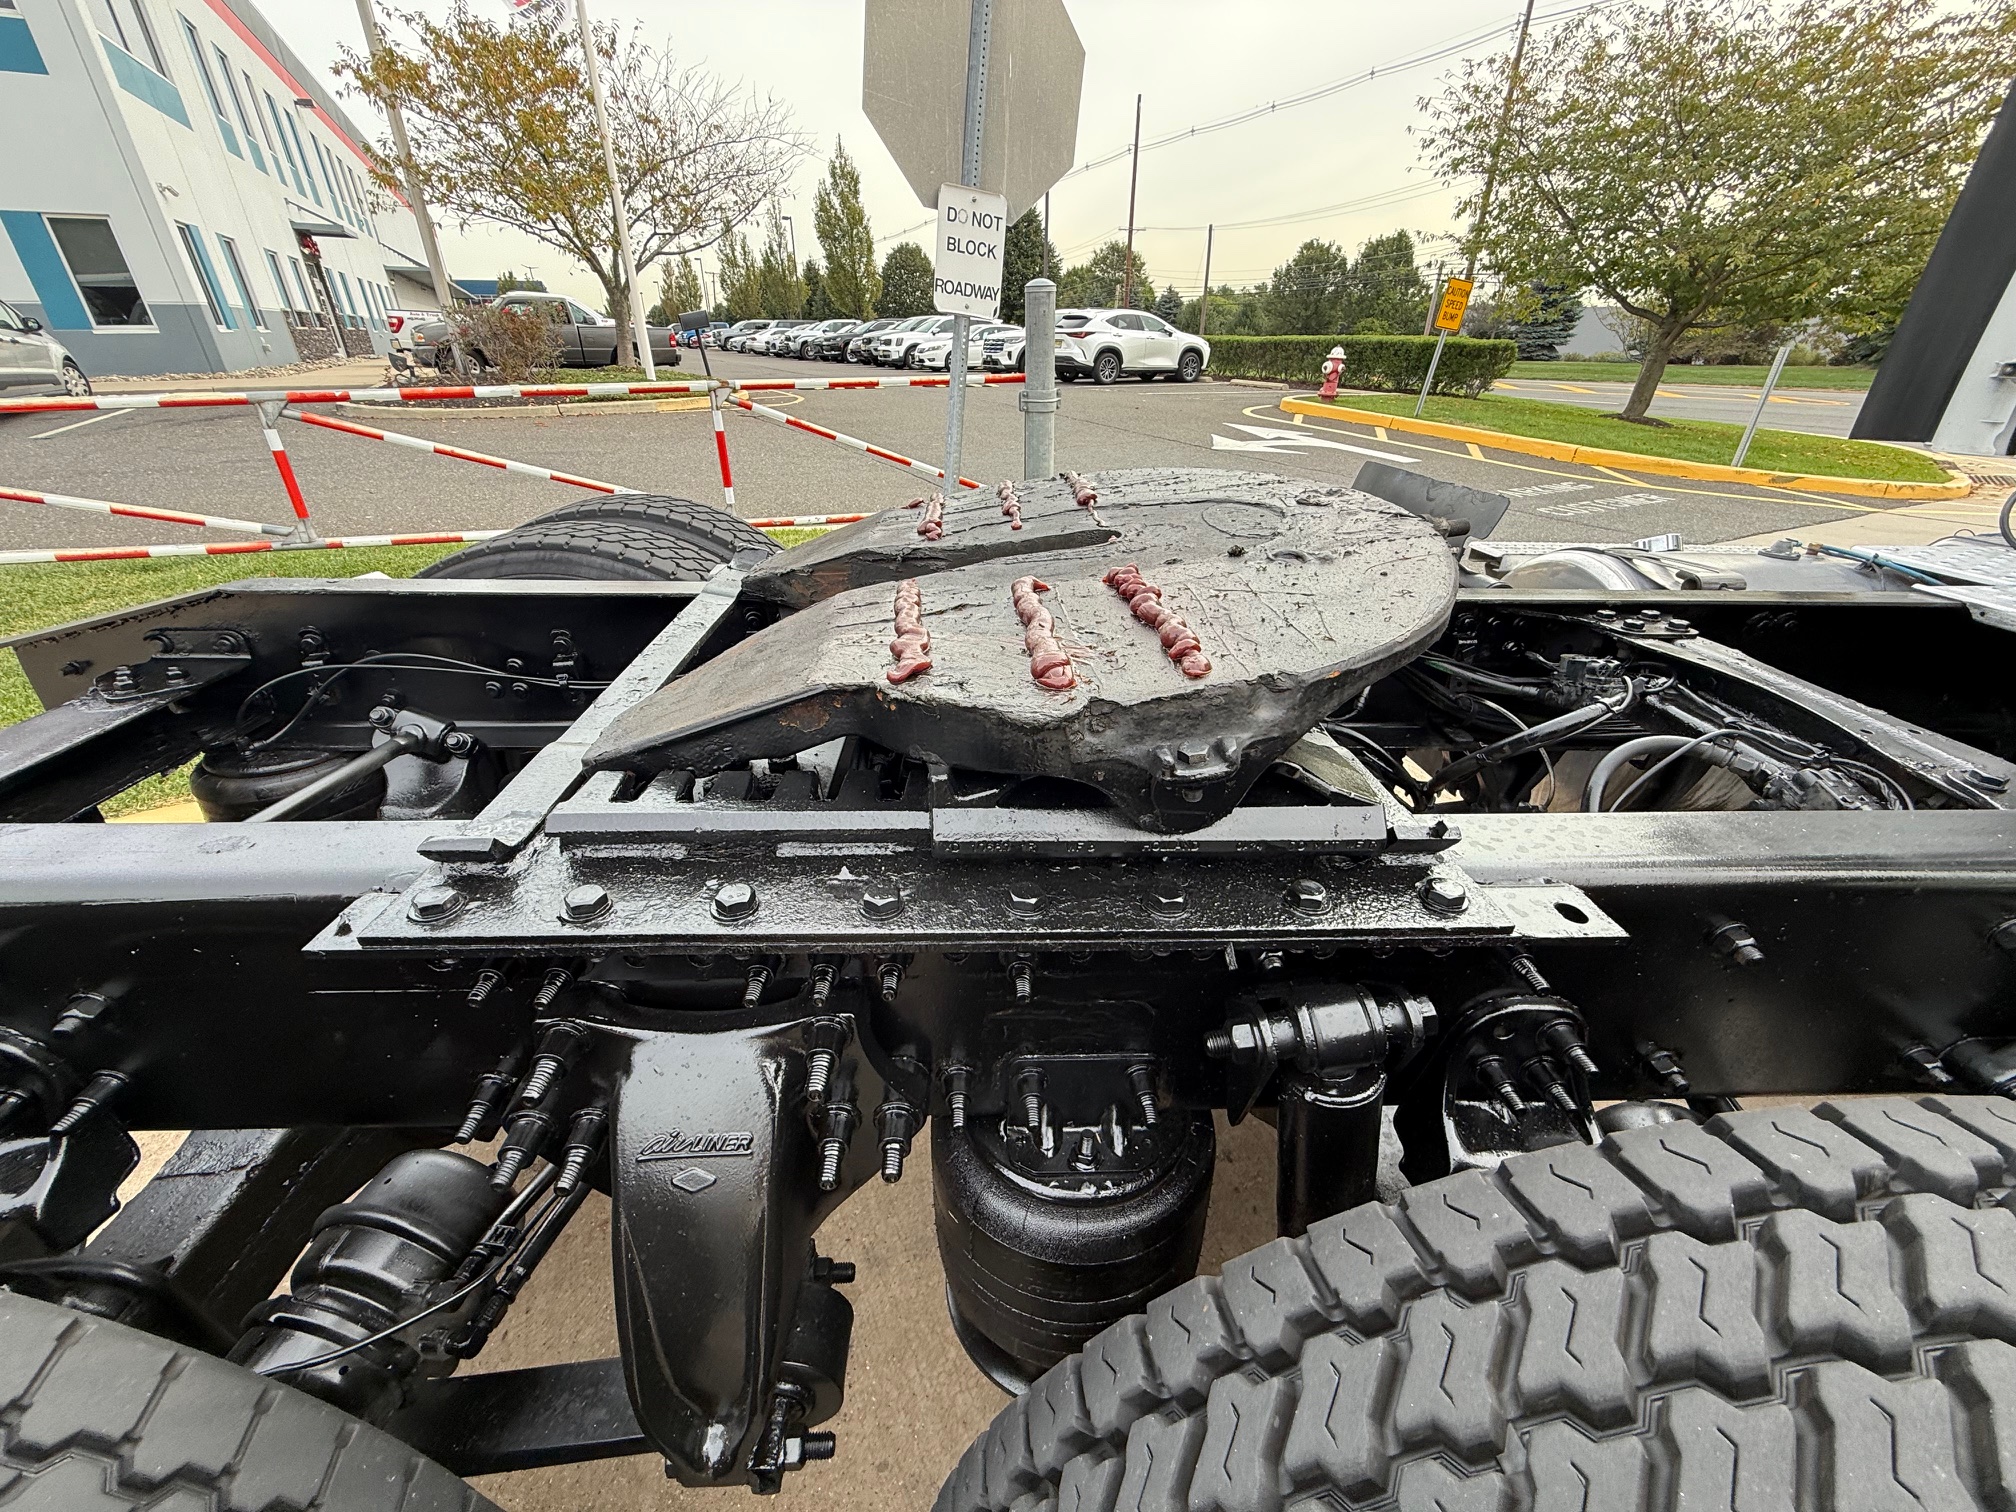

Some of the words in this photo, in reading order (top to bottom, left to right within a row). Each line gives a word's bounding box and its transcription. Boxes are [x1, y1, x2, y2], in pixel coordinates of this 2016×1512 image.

[947, 206, 969, 225] DO
[972, 211, 1003, 231] NOT
[946, 236, 998, 260] BLOCK
[934, 277, 1000, 301] ROADWAY
[1447, 286, 1469, 298] CAUTION
[1445, 298, 1463, 311] SPEED
[1442, 311, 1459, 322] BUMP
[1496, 481, 1594, 498] ARKING
[1536, 493, 1676, 516] CUSTOMER
